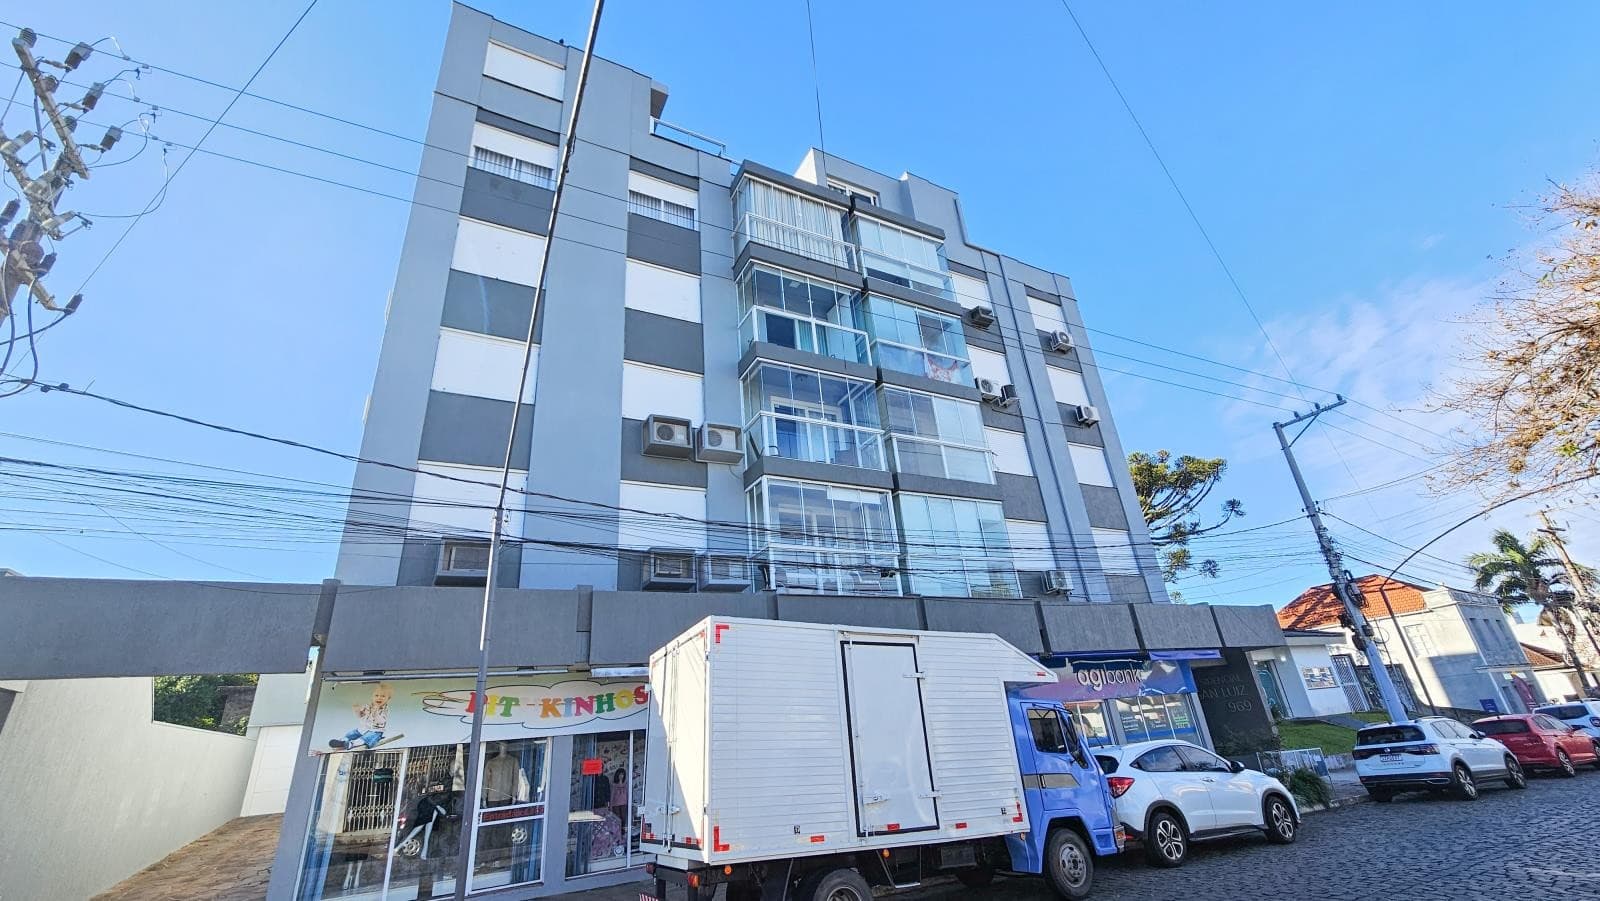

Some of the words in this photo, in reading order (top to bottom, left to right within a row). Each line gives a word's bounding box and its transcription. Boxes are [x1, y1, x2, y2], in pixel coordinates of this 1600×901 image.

[1076, 664, 1142, 691] agibank
[540, 685, 648, 718] KINHOS
[1227, 699, 1252, 712] 969
